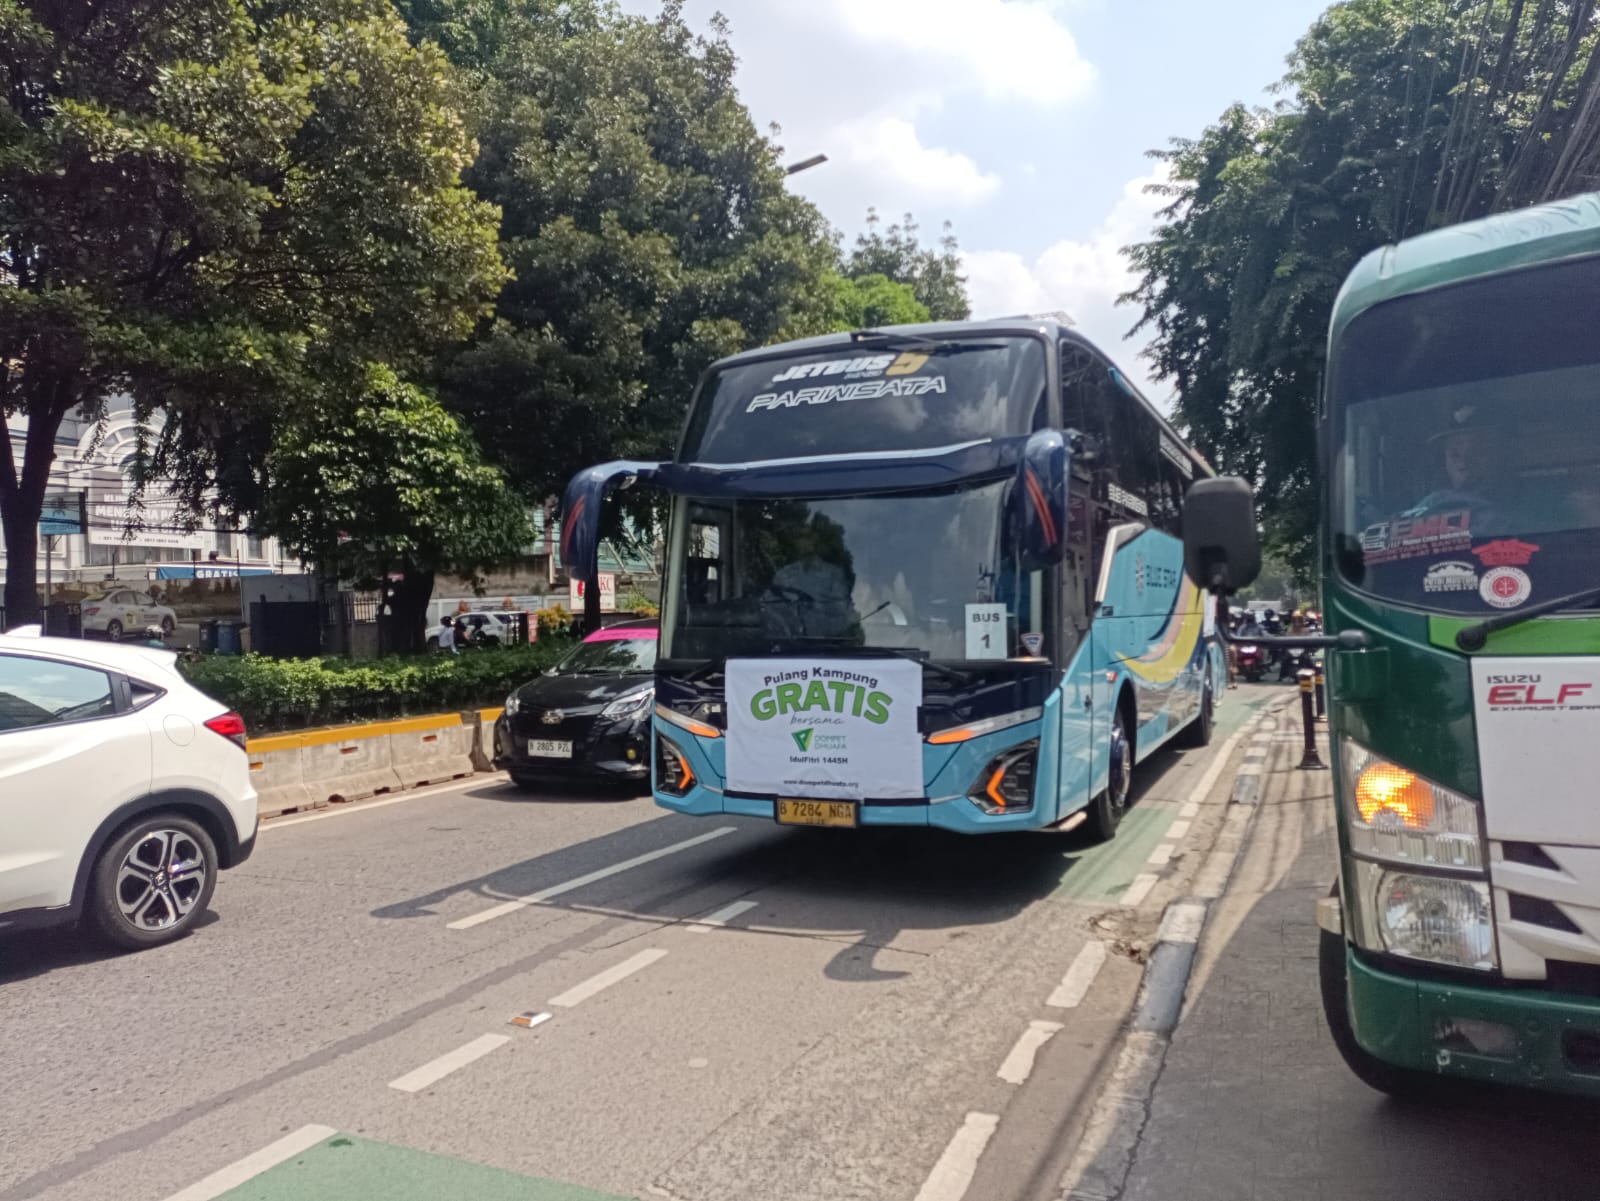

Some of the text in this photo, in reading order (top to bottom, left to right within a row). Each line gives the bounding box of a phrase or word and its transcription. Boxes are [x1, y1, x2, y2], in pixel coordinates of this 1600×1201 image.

[772, 353, 897, 382] JETBUS
[745, 376, 947, 413] PARIWISATA
[196, 569, 239, 579] GRATIS
[972, 613, 1000, 623] BUS
[981, 633, 991, 649] 1
[764, 666, 878, 688] Pulang Kampung
[1487, 674, 1542, 684] ISUZU
[750, 680, 893, 725] GRATIS
[1487, 683, 1593, 705] ELF
[790, 712, 845, 726] bersama
[822, 756, 848, 766] 1445H
[779, 800, 852, 819] B 7284 NGA
